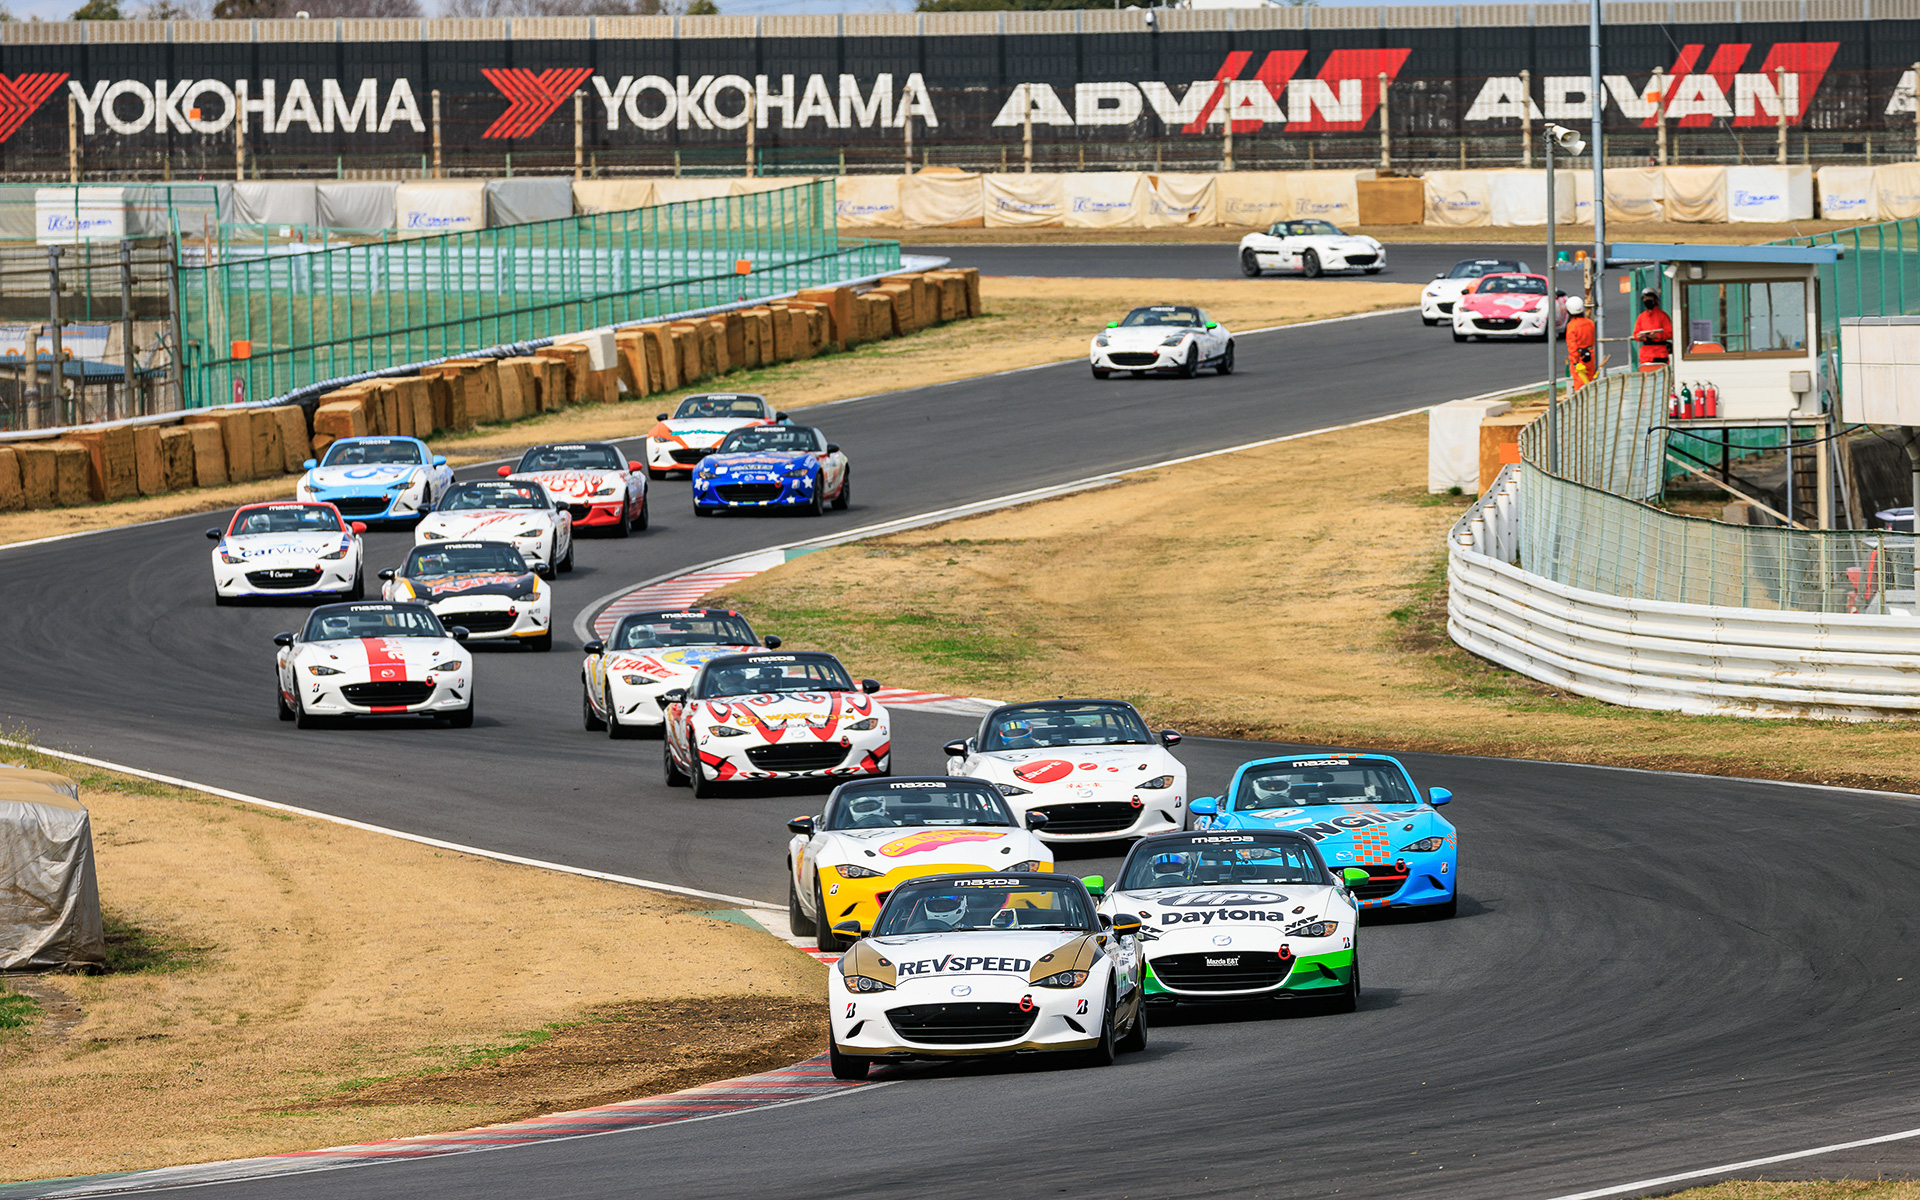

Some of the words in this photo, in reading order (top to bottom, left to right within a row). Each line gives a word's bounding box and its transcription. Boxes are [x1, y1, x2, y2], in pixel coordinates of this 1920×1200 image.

[592, 72, 939, 131] YOKOHAMA
[1464, 72, 1799, 121] ADVAN
[68, 77, 426, 136] YOKOHAMA
[992, 78, 1362, 127] ADVAN
[350, 604, 393, 612] mazda
[748, 655, 796, 663] mazda
[1292, 758, 1350, 768] mazda
[889, 781, 947, 790] mazda
[1191, 835, 1255, 844] mazda
[953, 878, 1020, 888] mazda
[1161, 908, 1284, 925] Daytona
